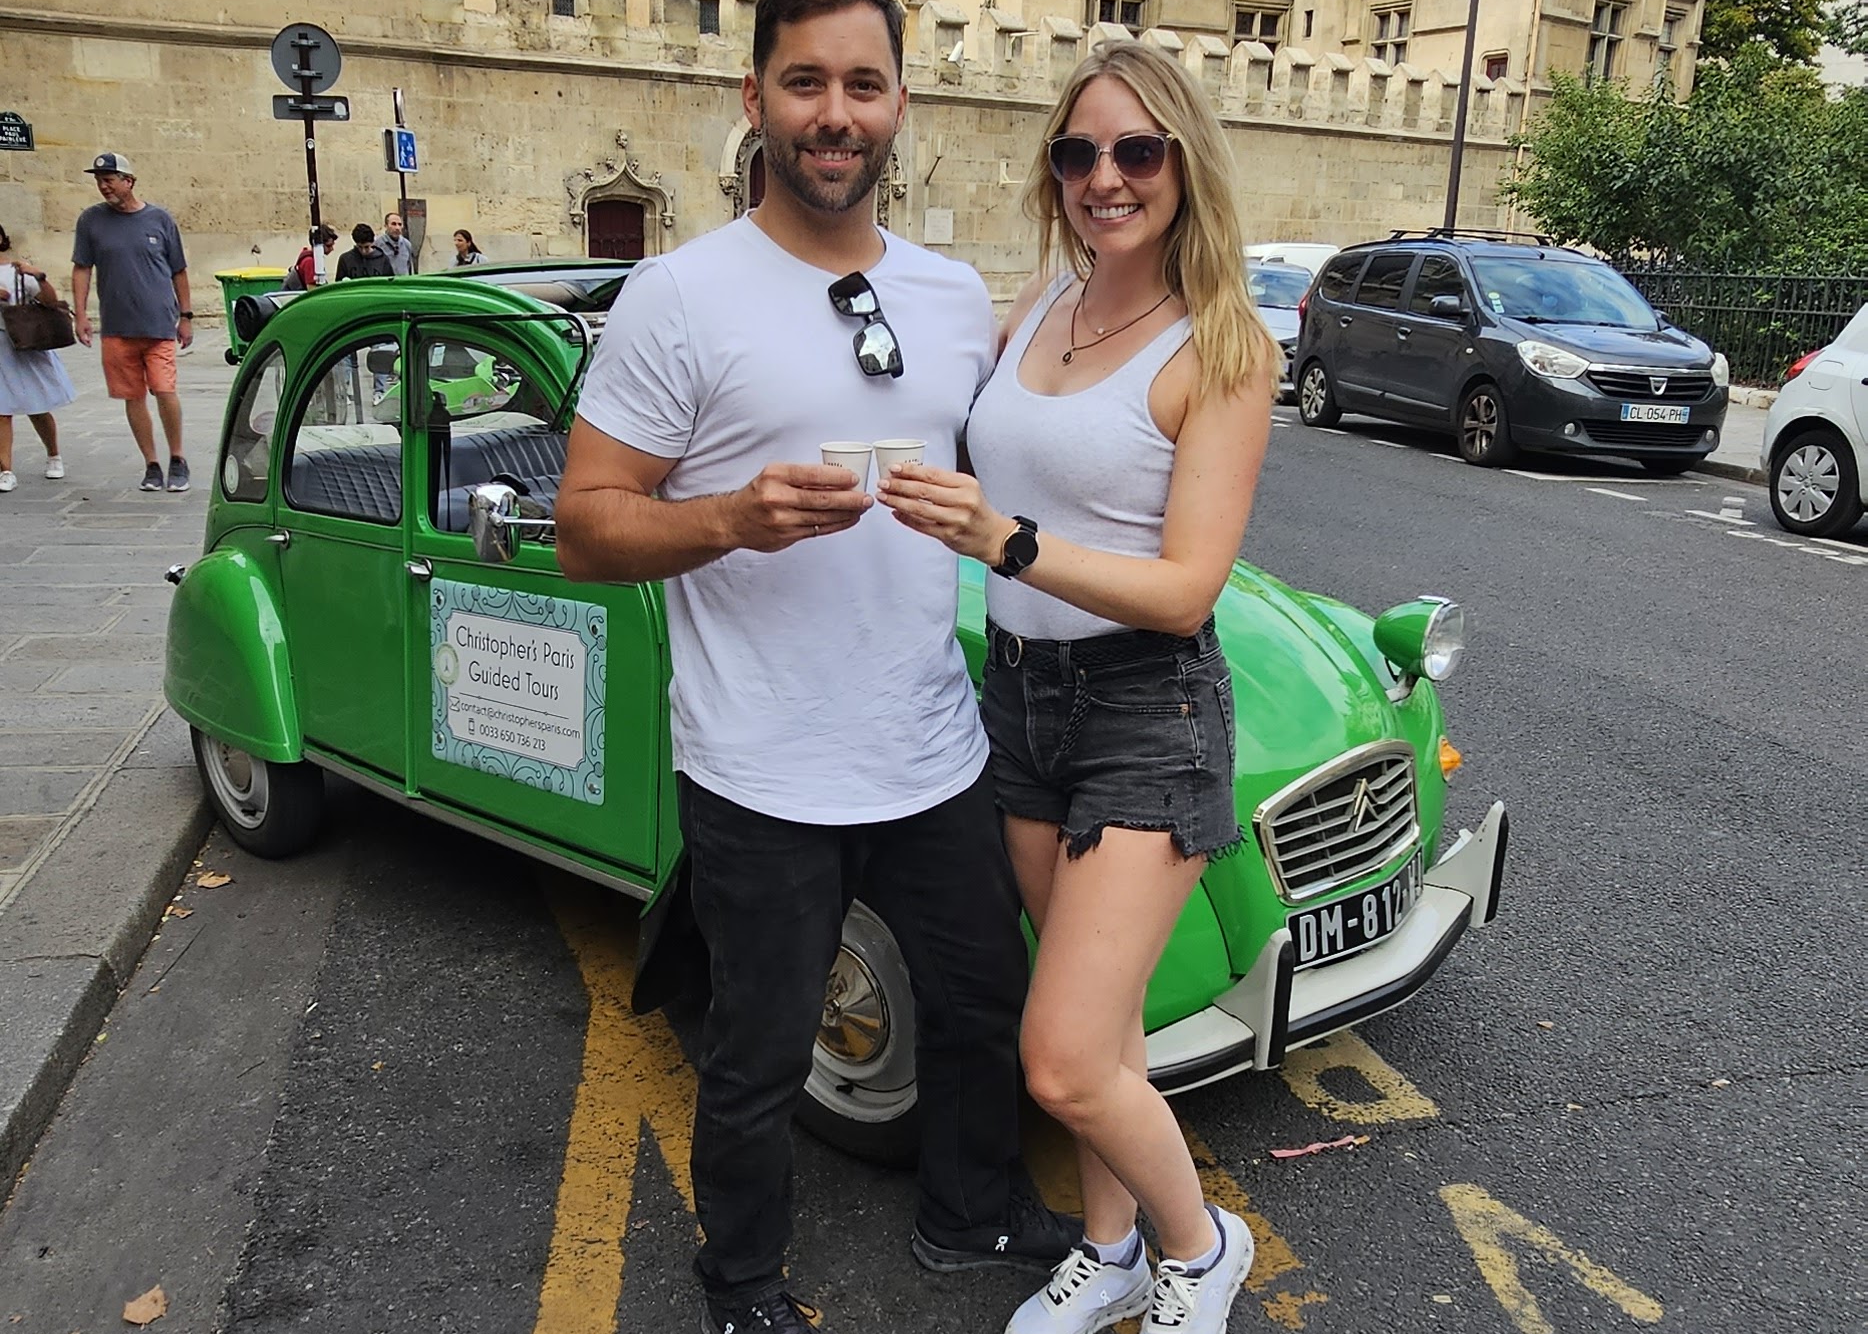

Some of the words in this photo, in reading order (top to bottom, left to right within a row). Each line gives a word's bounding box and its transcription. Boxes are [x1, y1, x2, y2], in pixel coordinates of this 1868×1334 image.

[456, 625, 537, 662] Christopher's
[543, 642, 575, 670] Paris
[468, 660, 520, 691] Guided
[525, 672, 559, 701] Tours
[460, 702, 581, 739] contact@christophersparis.com
[479, 724, 499, 739] 0033
[500, 729, 515, 743] 650
[533, 737, 546, 751] 213
